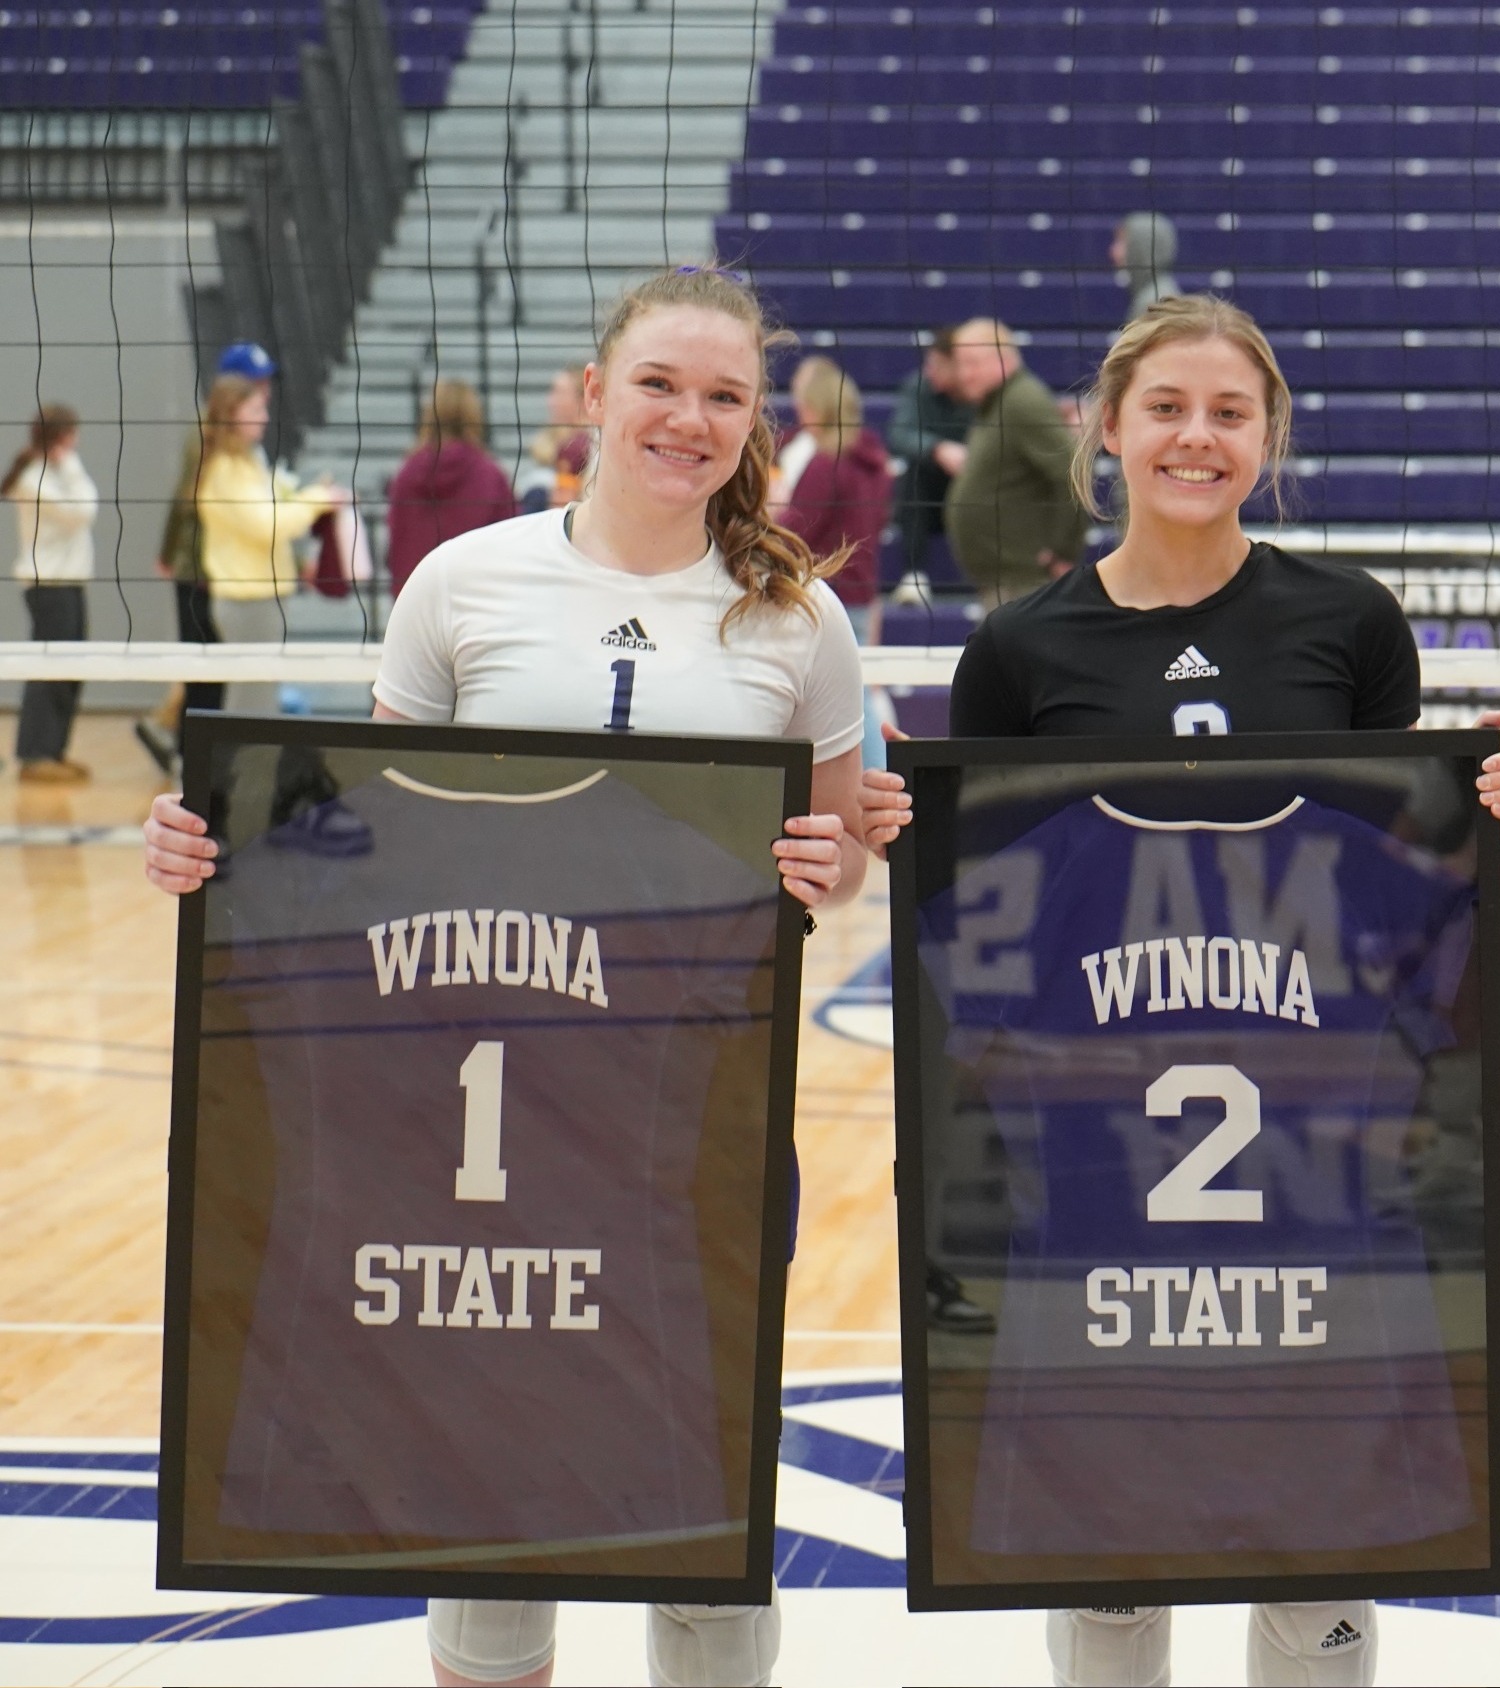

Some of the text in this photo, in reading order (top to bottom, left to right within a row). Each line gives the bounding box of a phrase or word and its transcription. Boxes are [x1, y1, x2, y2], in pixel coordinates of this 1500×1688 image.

[600, 635, 657, 652] adidas
[1164, 665, 1220, 681] adidas
[603, 658, 636, 730] 1
[368, 909, 608, 1007] WINONA
[1082, 936, 1319, 1027] WINONA
[456, 1041, 506, 1201] 1
[1146, 1065, 1263, 1221] 2
[355, 1244, 601, 1329] STATE
[1087, 1267, 1327, 1347] STATE
[1321, 1631, 1361, 1648] adidas
